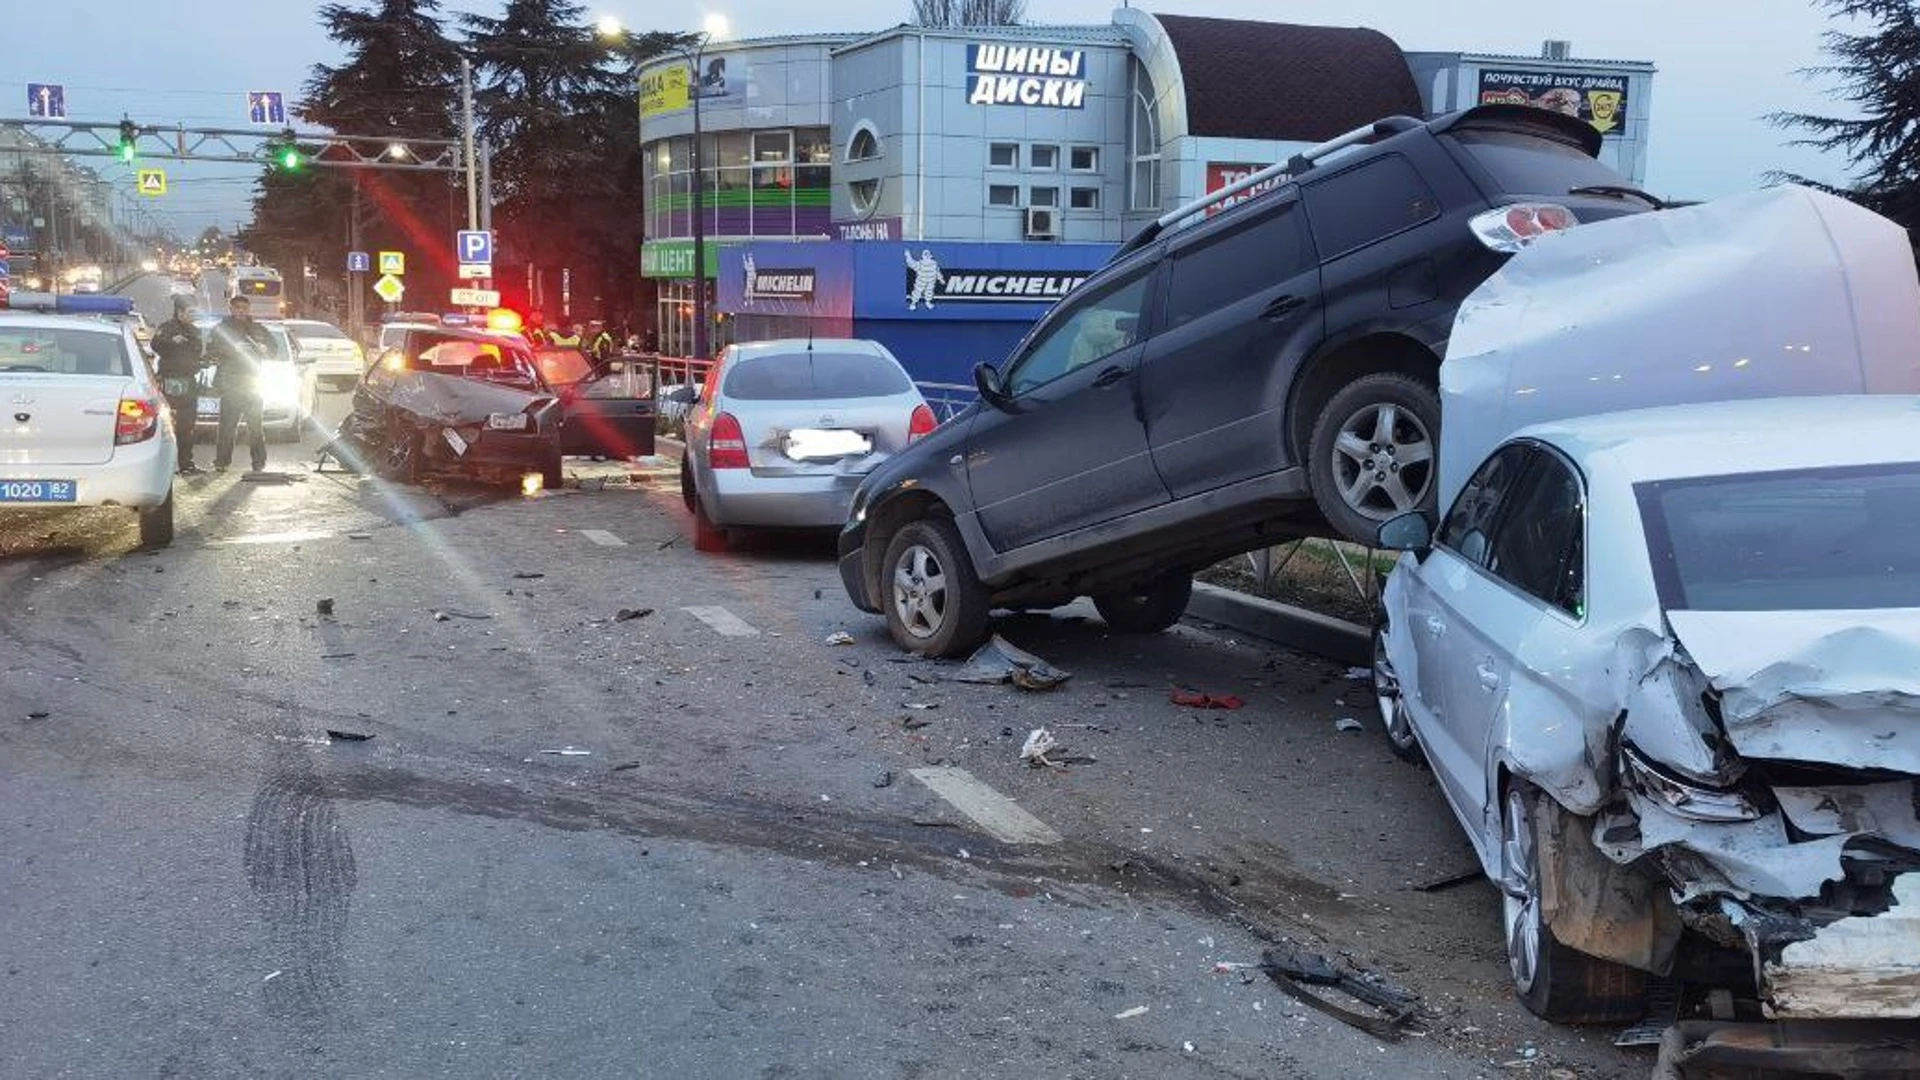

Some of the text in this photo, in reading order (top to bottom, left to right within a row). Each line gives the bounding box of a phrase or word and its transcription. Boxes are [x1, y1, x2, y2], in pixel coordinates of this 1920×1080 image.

[975, 44, 1081, 76] ШИНЫ
[970, 75, 1085, 107] ДИСКИ
[1484, 73, 1552, 86] ПОЧУВСТВУЙ
[1554, 75, 1582, 87] ВКУС
[876, 222, 889, 240] НА
[467, 235, 485, 259] P
[661, 248, 696, 273] ЦЕНТ
[757, 275, 813, 292] MICHELIN
